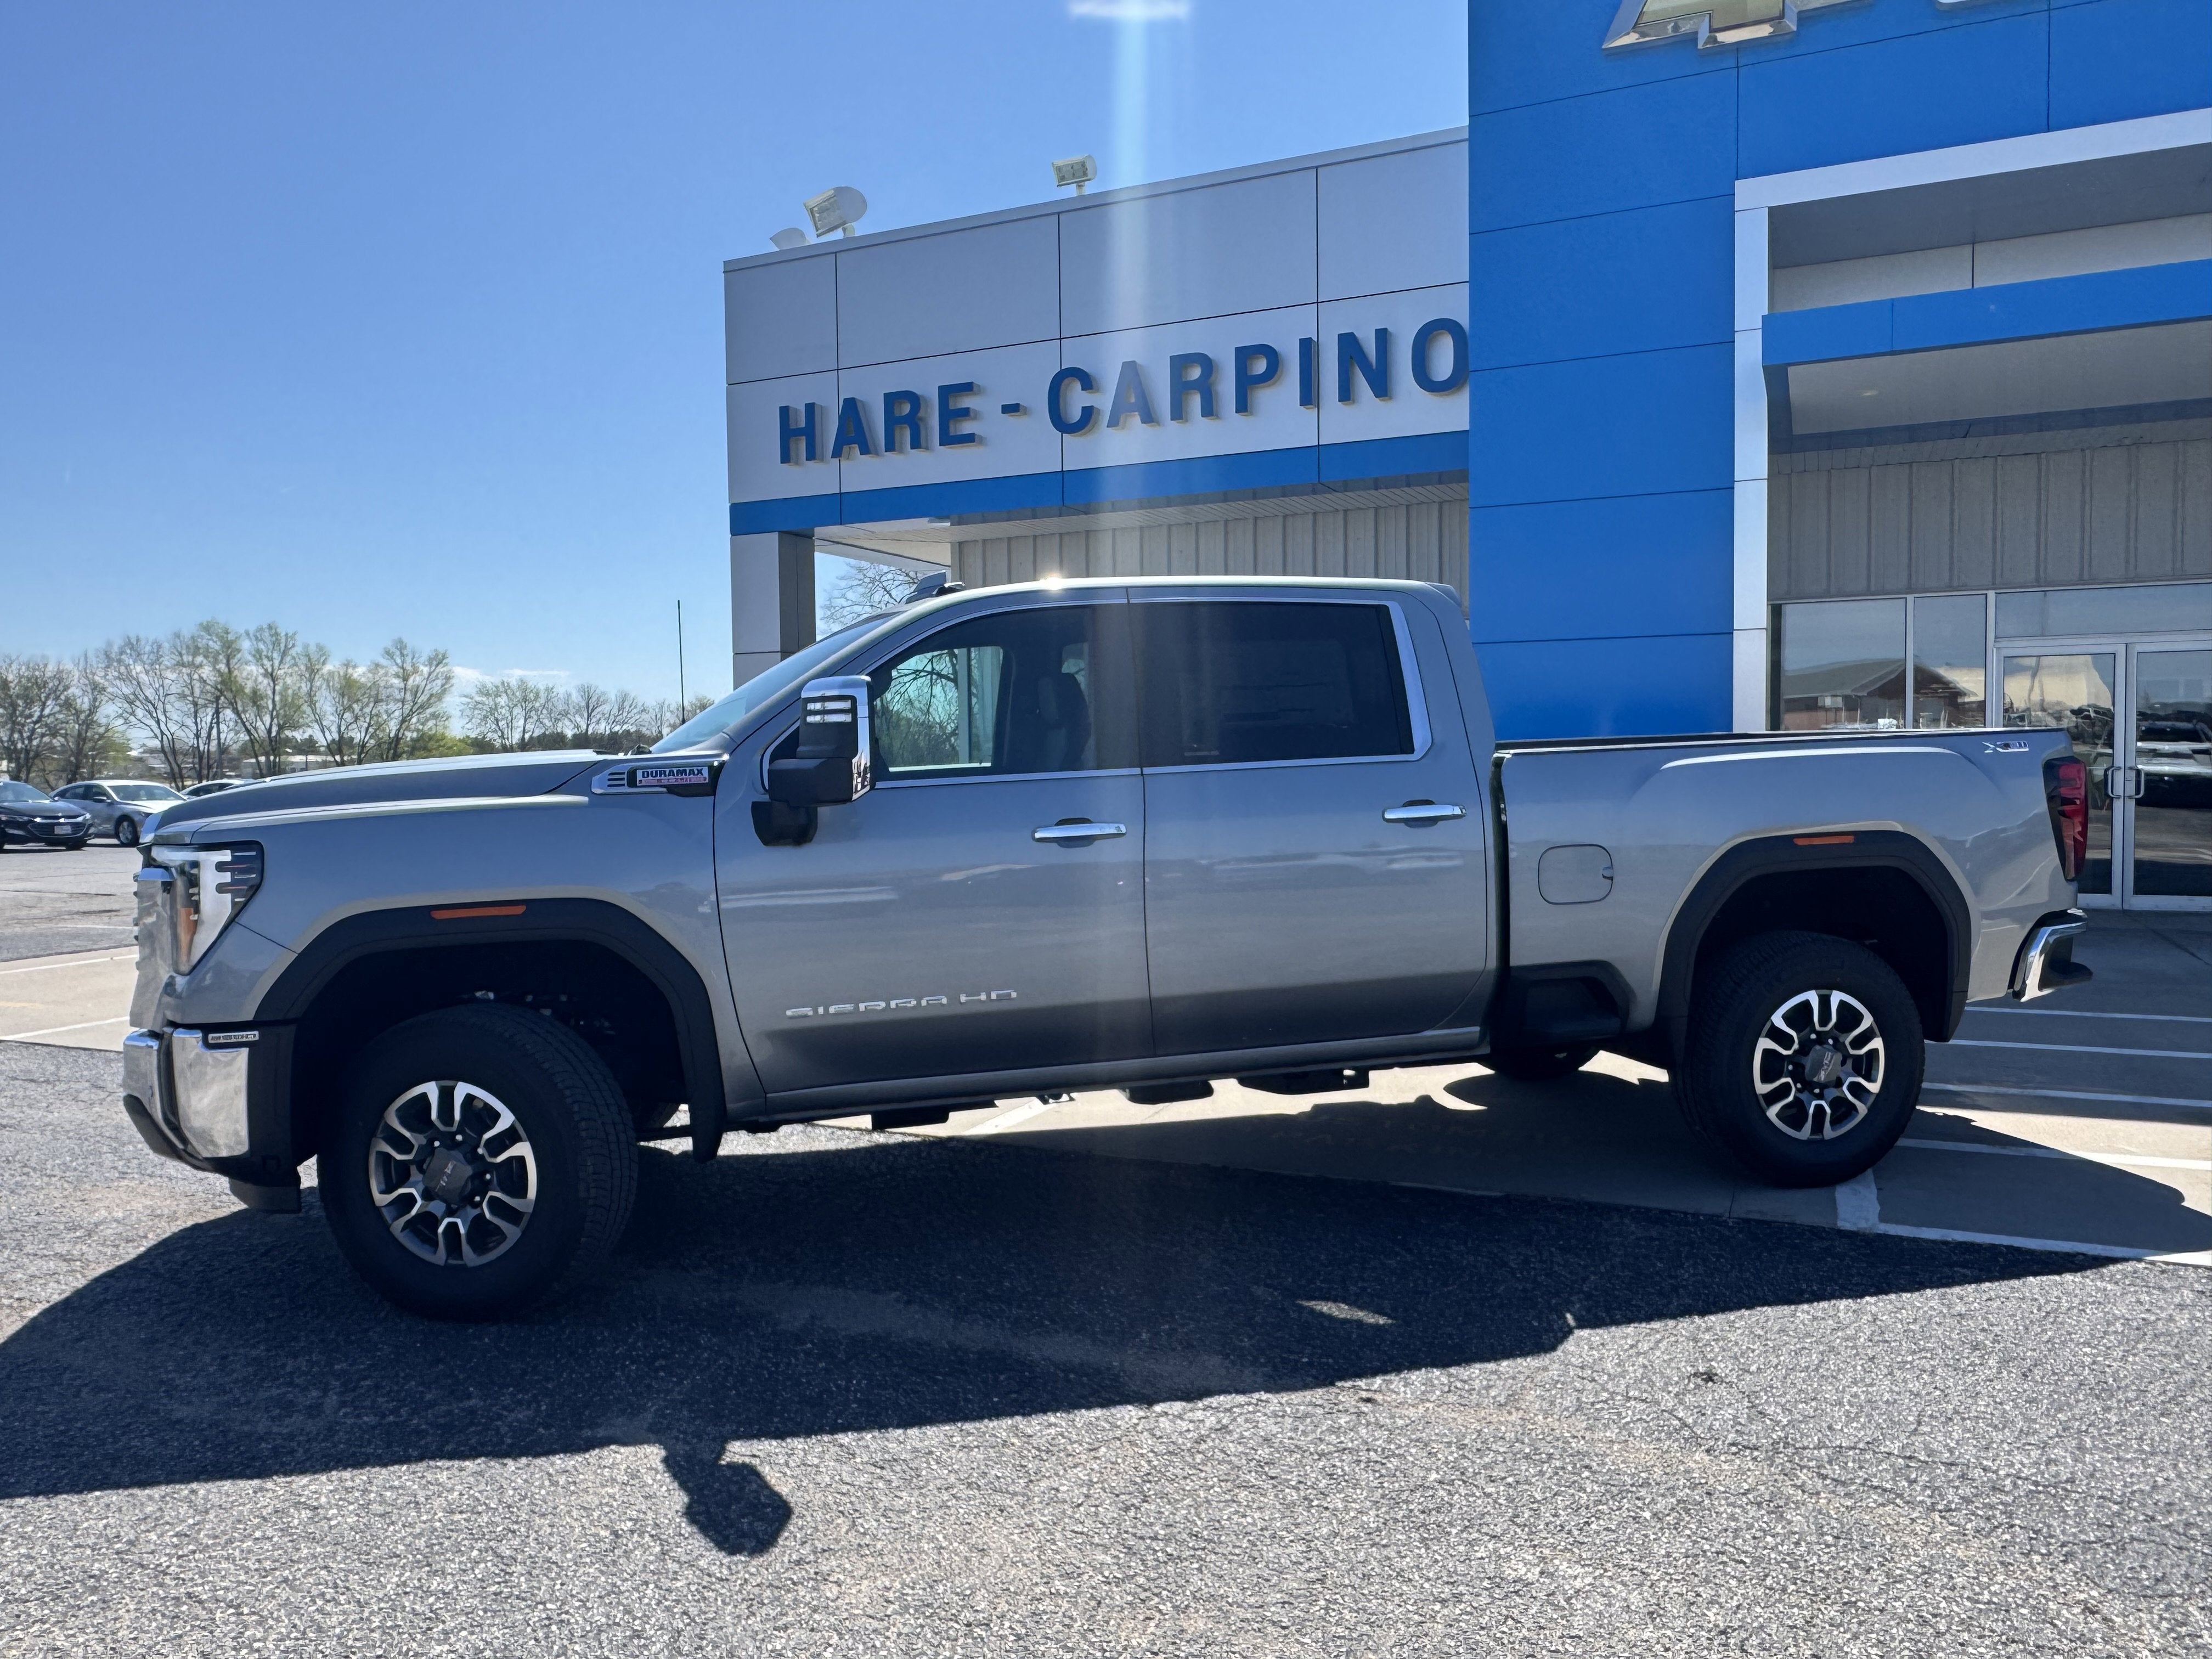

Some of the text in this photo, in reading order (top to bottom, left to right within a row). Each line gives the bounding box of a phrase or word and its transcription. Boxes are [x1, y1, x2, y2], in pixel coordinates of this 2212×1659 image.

[779, 381, 979, 464] HARE
[1047, 318, 1469, 436] CARPINO
[641, 768, 704, 778] DURAMAX
[785, 990, 1017, 1018] SIERRA HD
